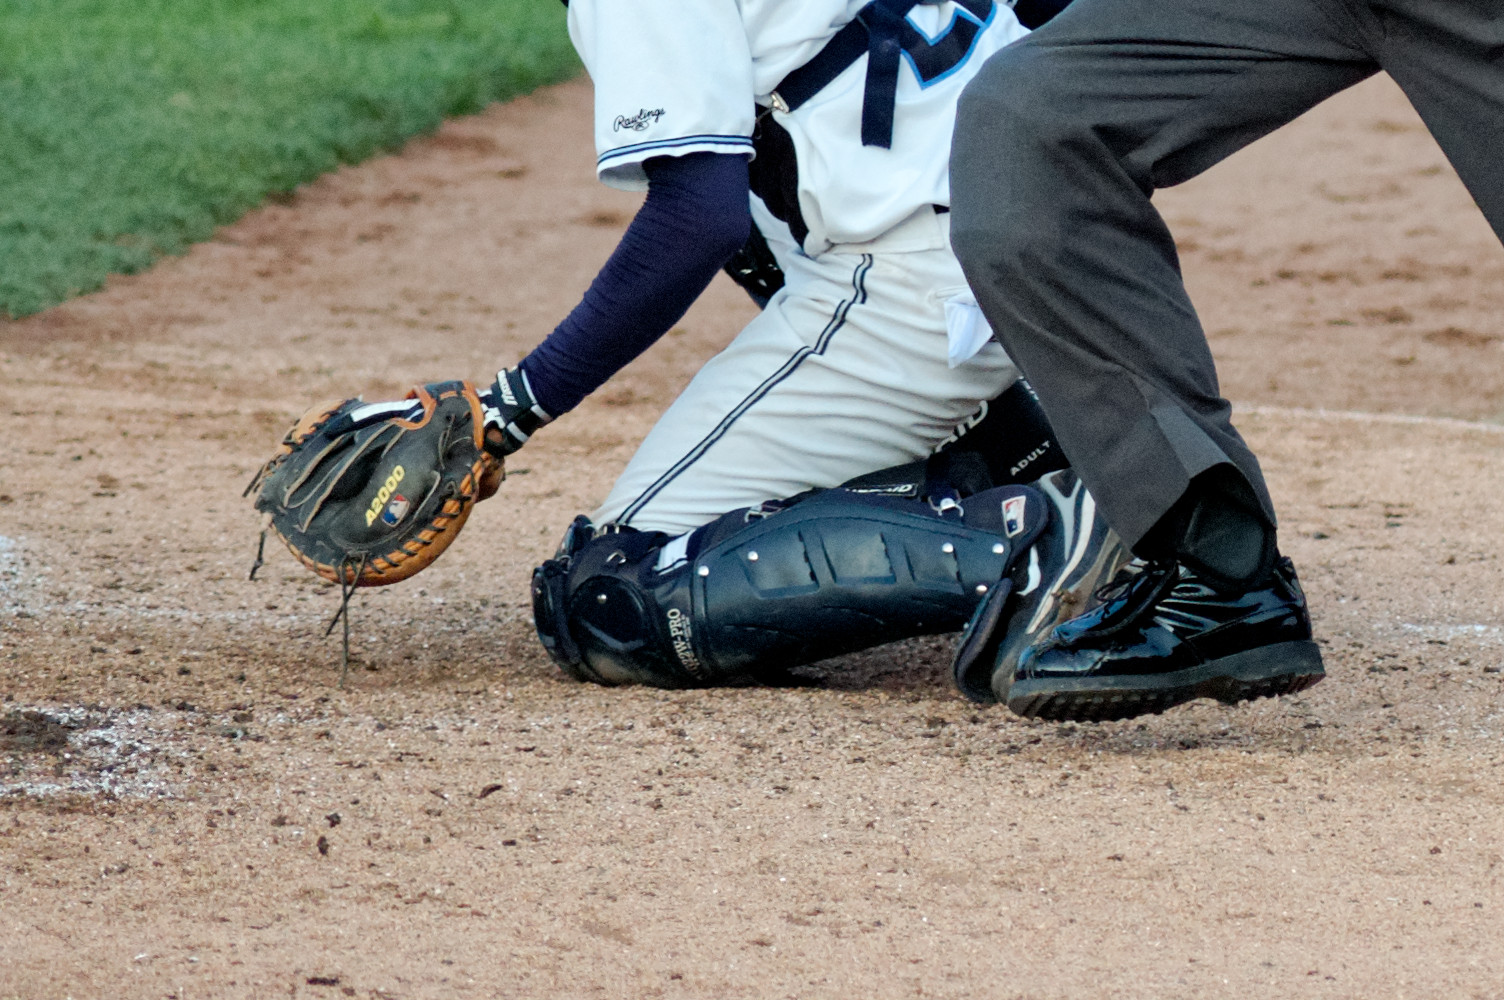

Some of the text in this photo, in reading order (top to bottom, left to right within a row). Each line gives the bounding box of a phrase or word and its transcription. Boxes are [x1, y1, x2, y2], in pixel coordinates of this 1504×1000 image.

[613, 107, 666, 133] Rawlings
[1009, 439, 1051, 477] ADULT
[365, 465, 405, 527] A2000
